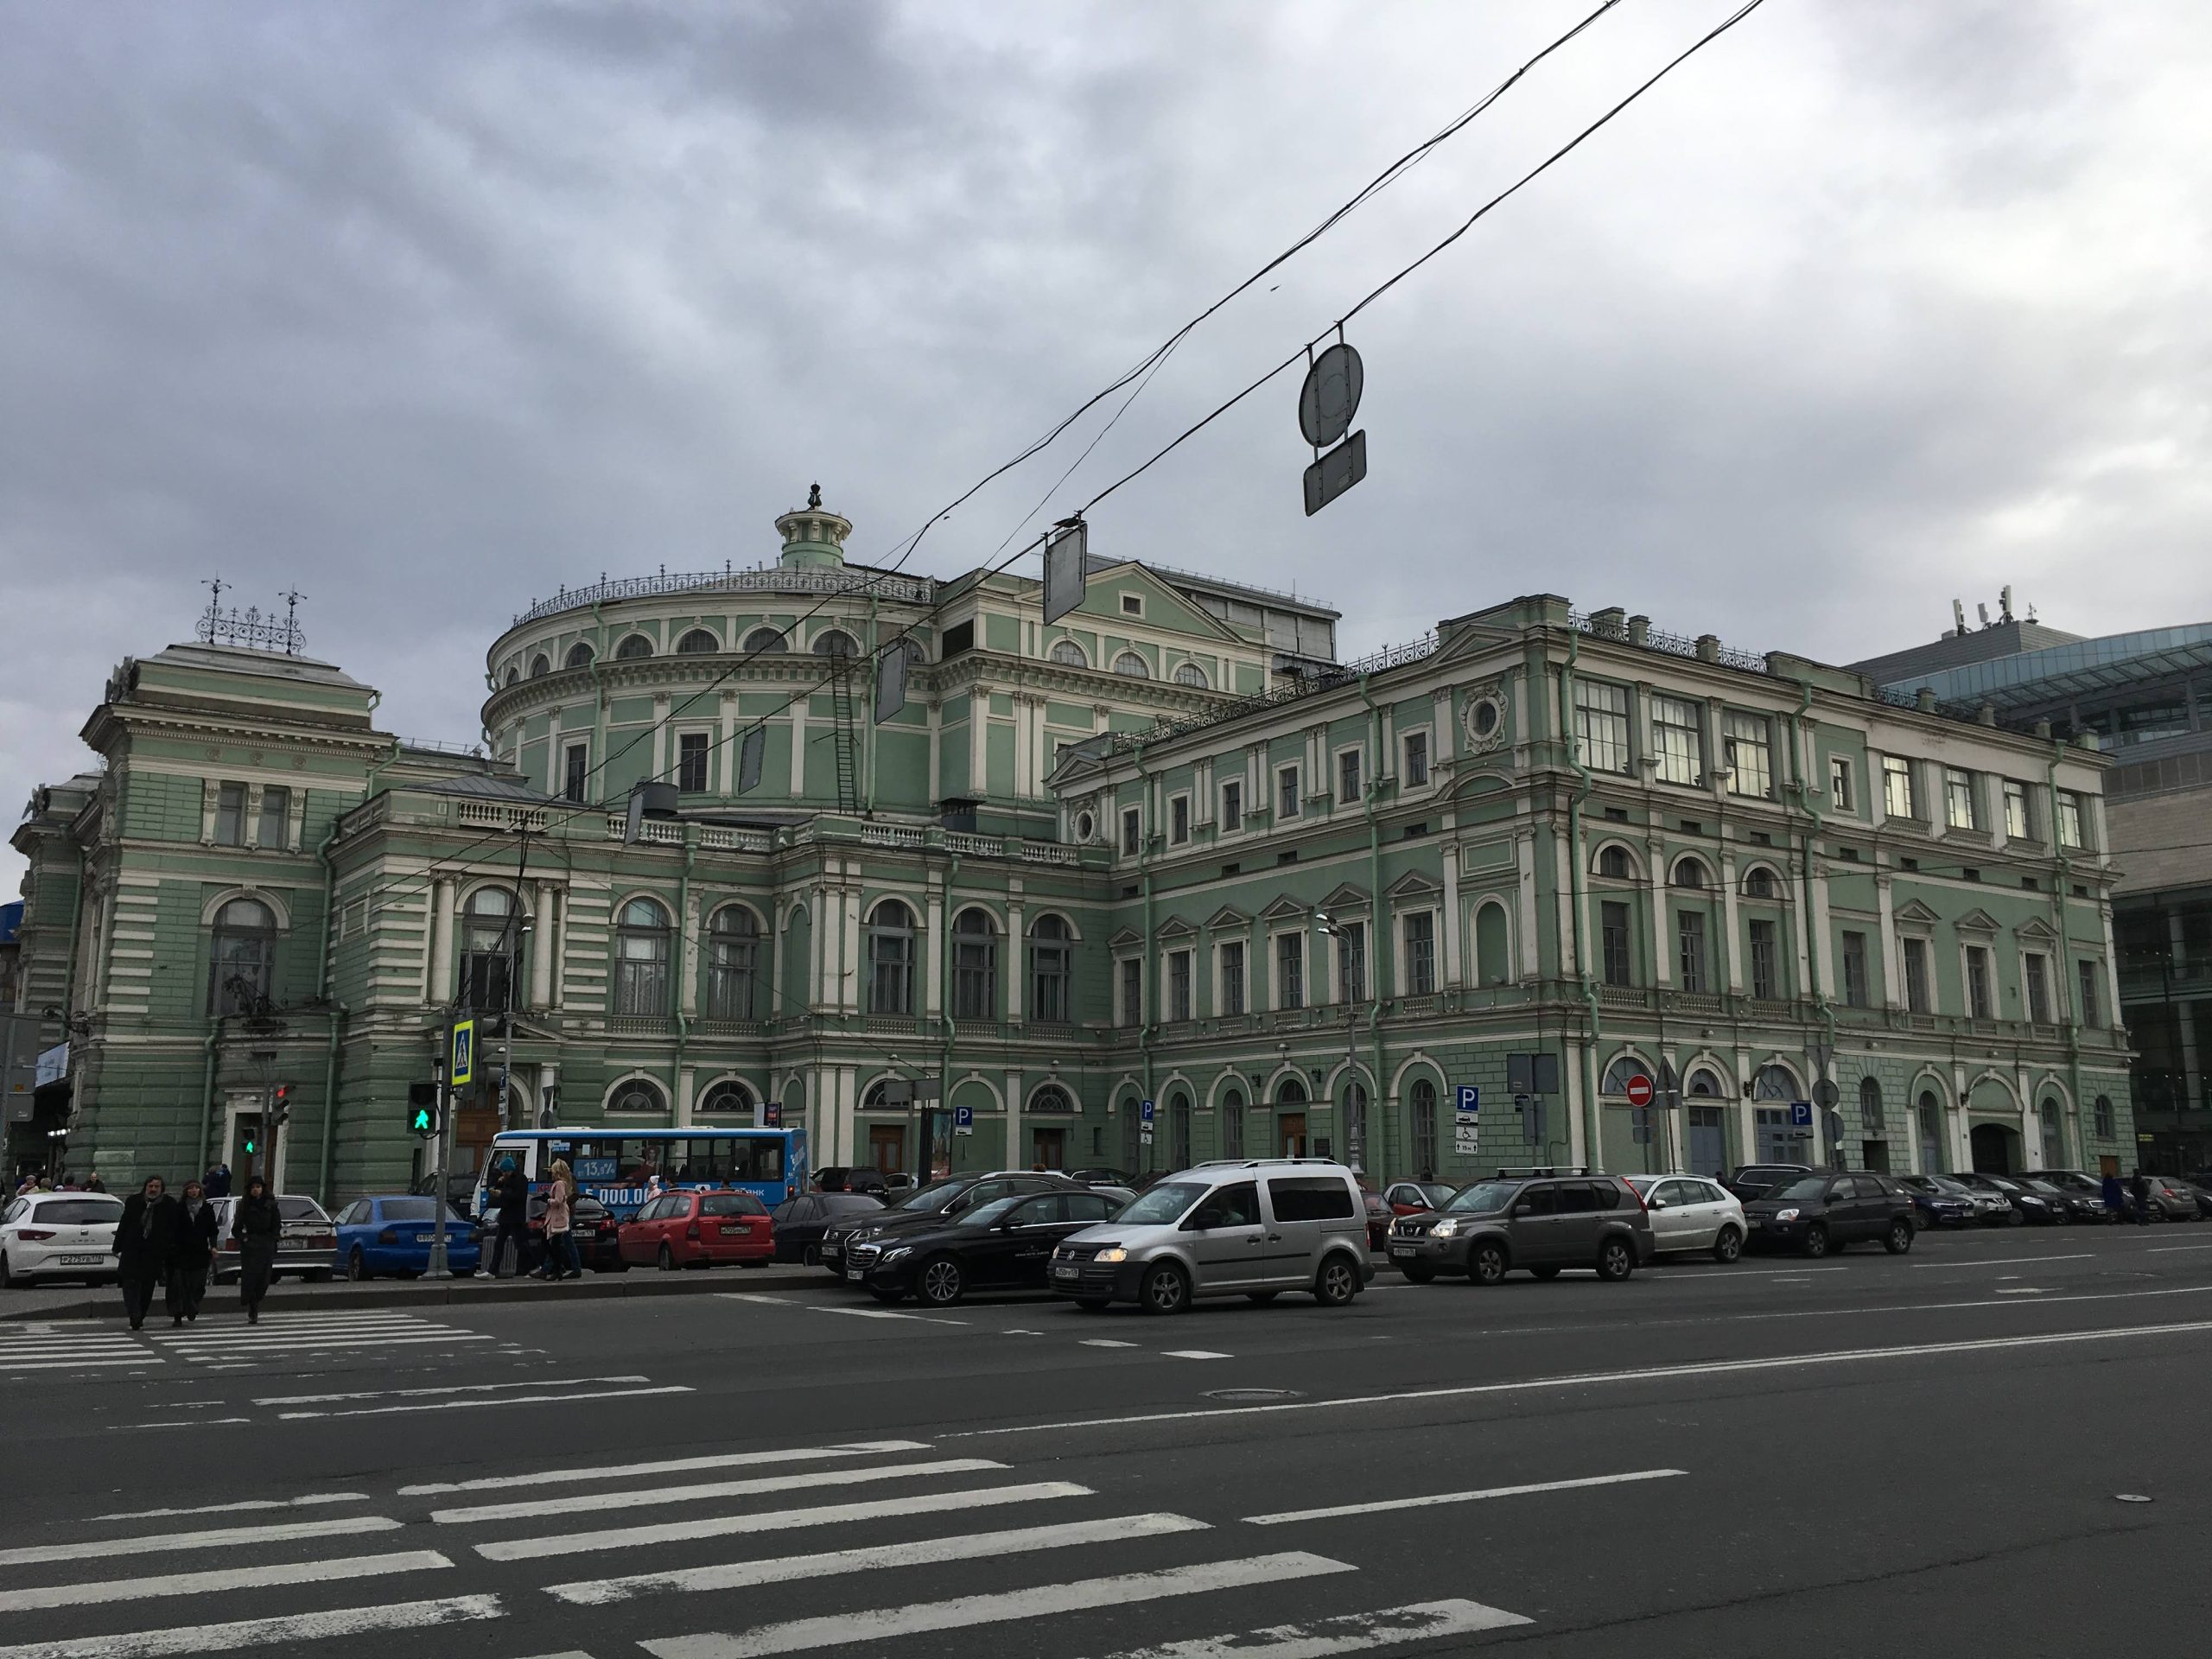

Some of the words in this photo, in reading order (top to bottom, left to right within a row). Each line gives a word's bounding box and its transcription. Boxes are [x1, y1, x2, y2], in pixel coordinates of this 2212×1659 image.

[1462, 1089, 1475, 1108] P
[958, 1108, 969, 1124] P
[1144, 1102, 1152, 1118] P
[1795, 1105, 1807, 1124] P
[584, 1161, 615, 1176] 13,9%
